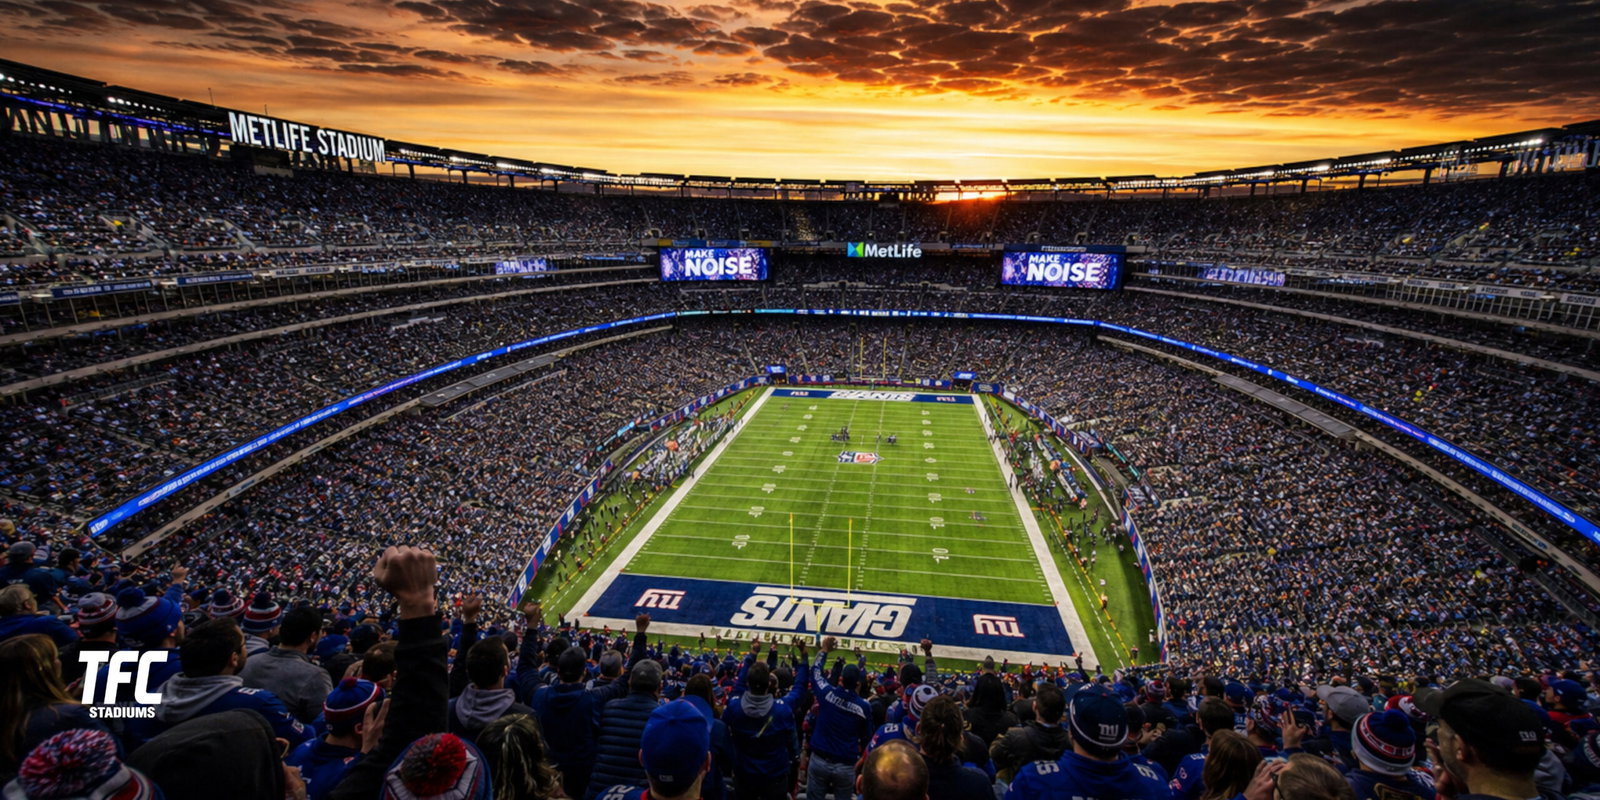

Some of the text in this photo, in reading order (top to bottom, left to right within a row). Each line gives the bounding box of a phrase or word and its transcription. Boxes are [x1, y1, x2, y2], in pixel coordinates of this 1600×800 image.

[228, 111, 386, 162] METLIFE STADIUM
[684, 249, 715, 259] MAKE
[864, 243, 922, 258] MetLife
[1028, 254, 1061, 264] MAKE
[684, 256, 753, 277] NOISE
[1026, 262, 1102, 282] NOISE
[729, 593, 913, 639] GIANTS
